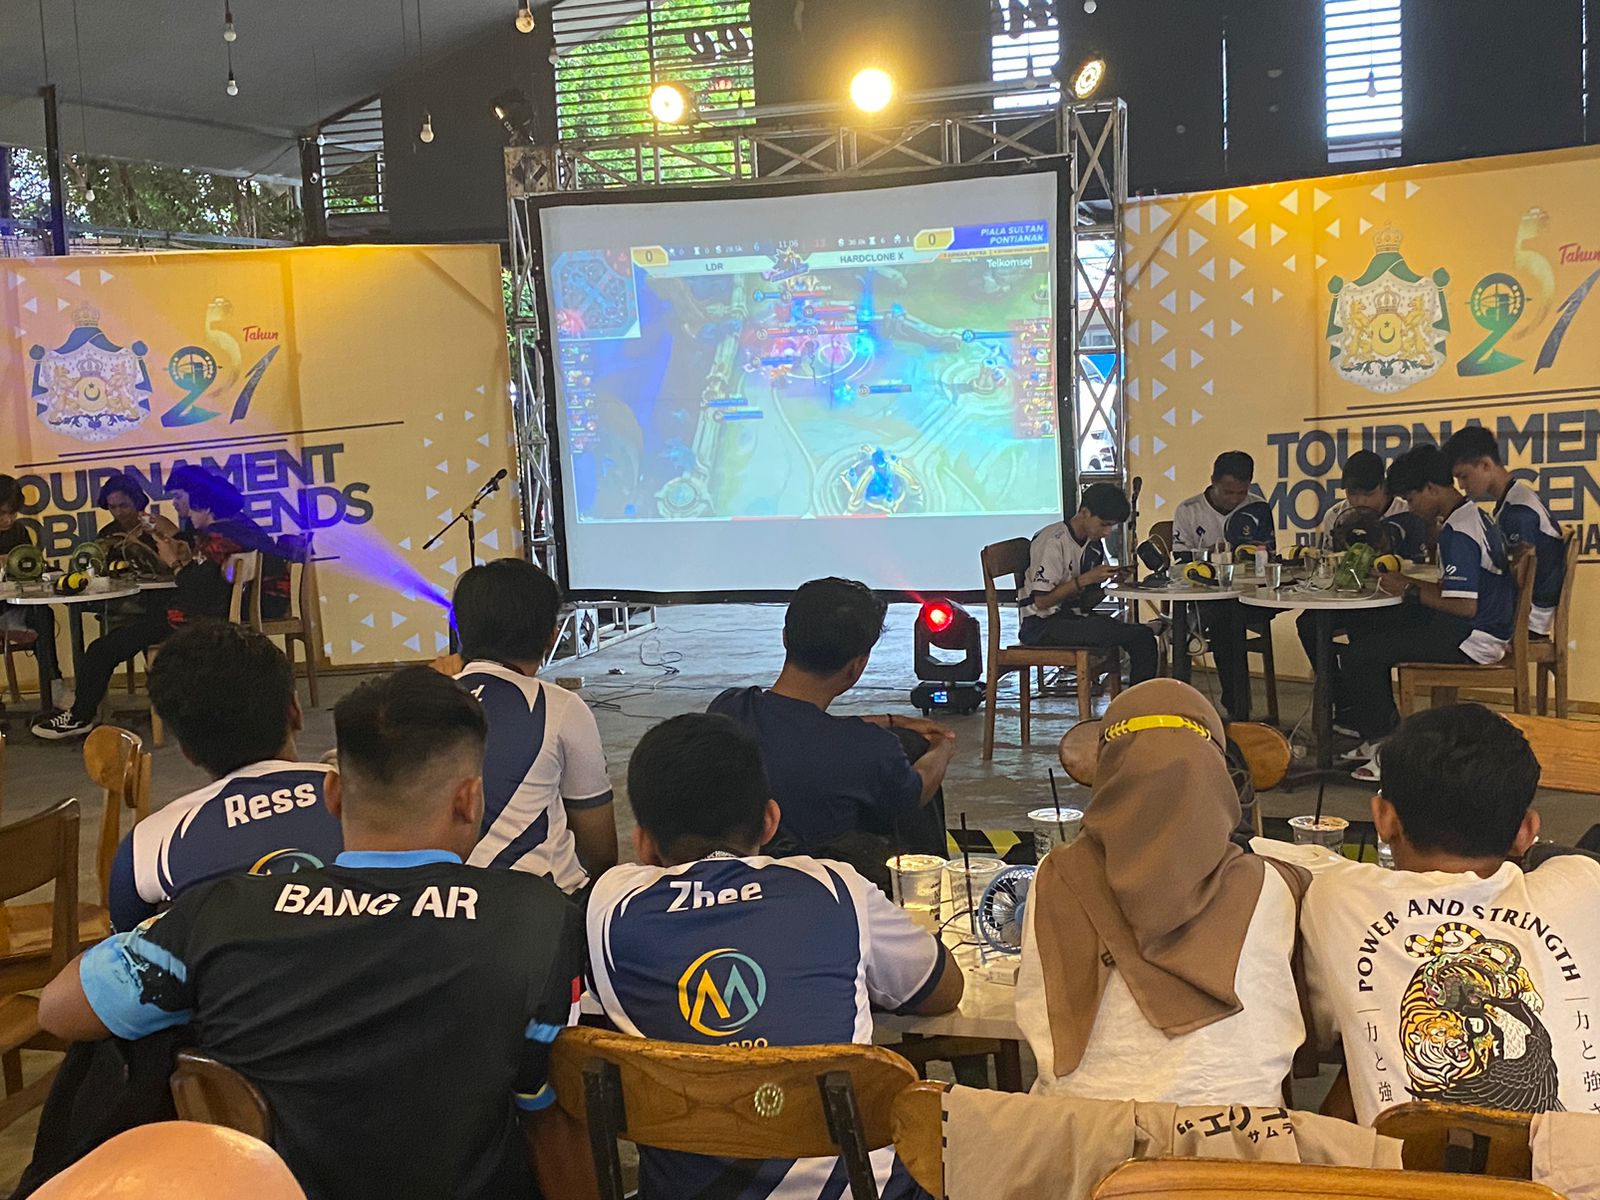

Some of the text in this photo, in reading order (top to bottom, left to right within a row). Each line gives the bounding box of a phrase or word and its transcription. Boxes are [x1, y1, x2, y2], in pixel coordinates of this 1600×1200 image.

[980, 224, 1044, 237] PIALA SULTAN
[990, 234, 1044, 245] PONTIANAK
[840, 252, 904, 264] HARDCLONE X
[705, 263, 724, 272] LDR
[243, 325, 278, 342] Tahun
[224, 782, 317, 828] Ress
[273, 883, 480, 920] BANG AR
[665, 880, 763, 913] Zhee
[1357, 910, 1399, 992] POWER
[1407, 898, 1464, 917] AND
